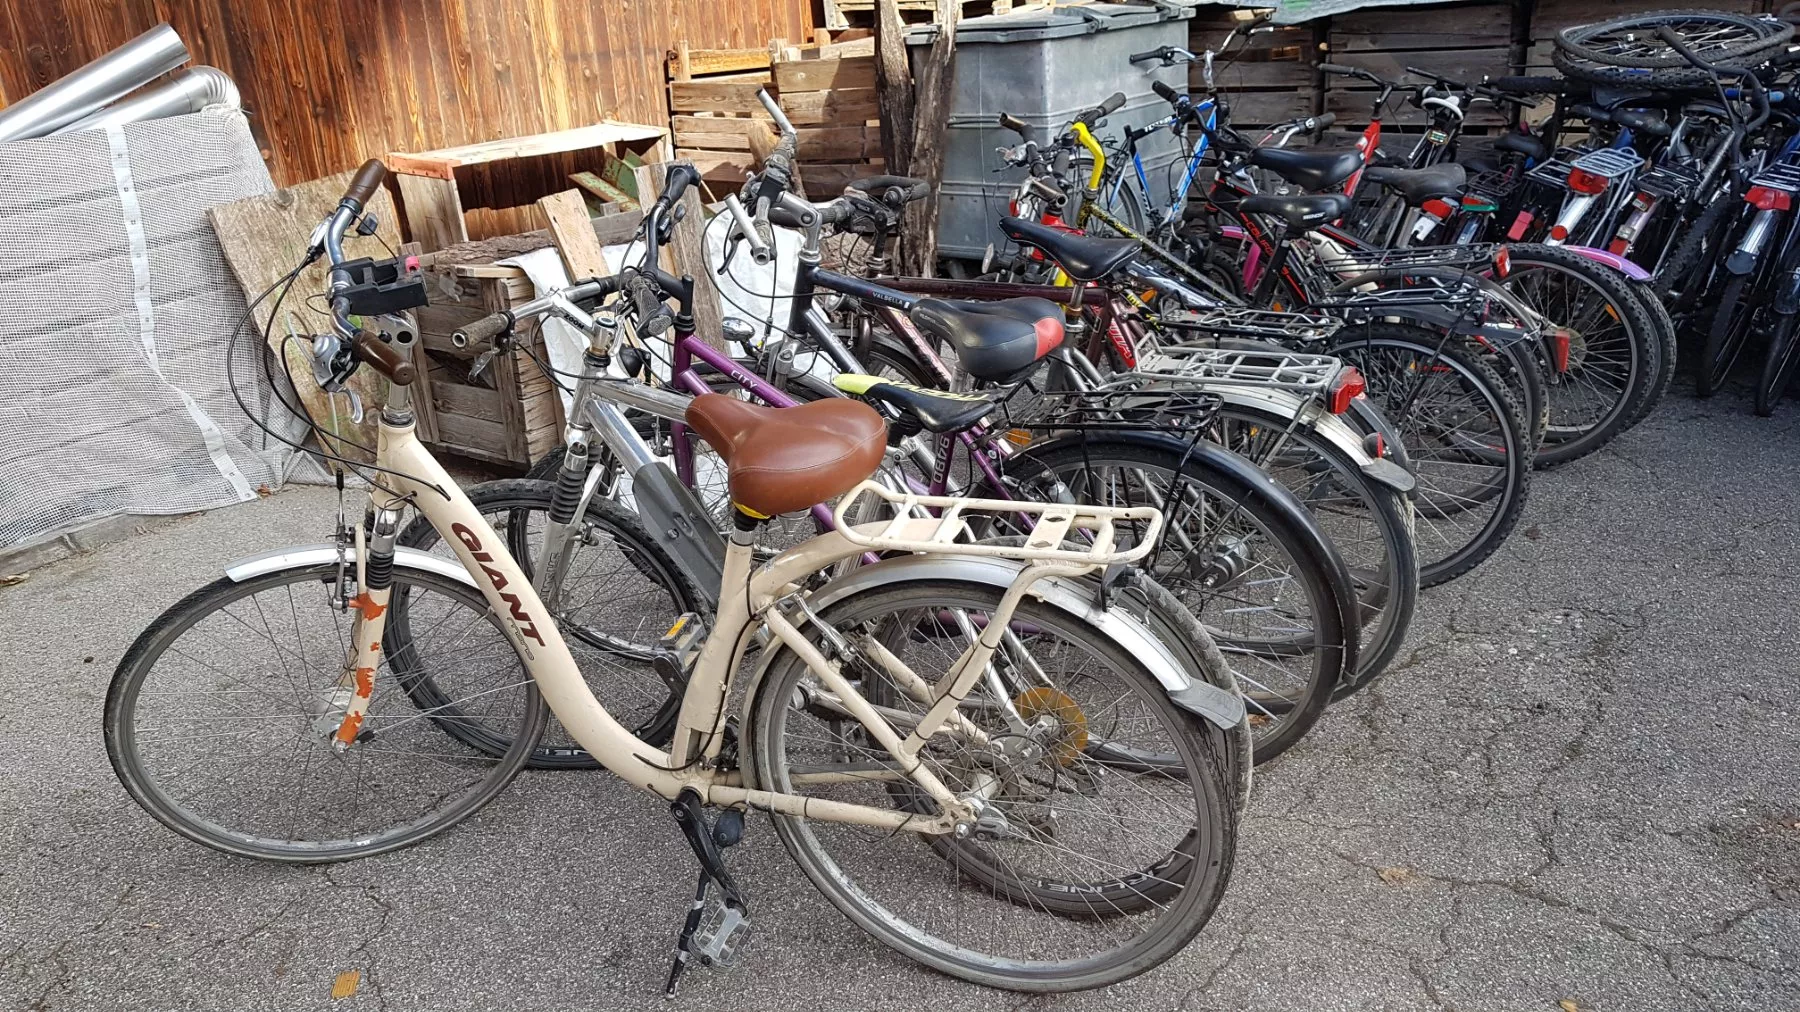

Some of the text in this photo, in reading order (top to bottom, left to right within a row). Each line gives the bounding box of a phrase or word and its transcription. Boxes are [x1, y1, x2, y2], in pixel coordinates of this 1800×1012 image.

[872, 291, 903, 305] VALBELLA
[563, 313, 585, 330] ZOOM
[731, 369, 758, 389] CITY
[451, 522, 546, 647] GIANT
